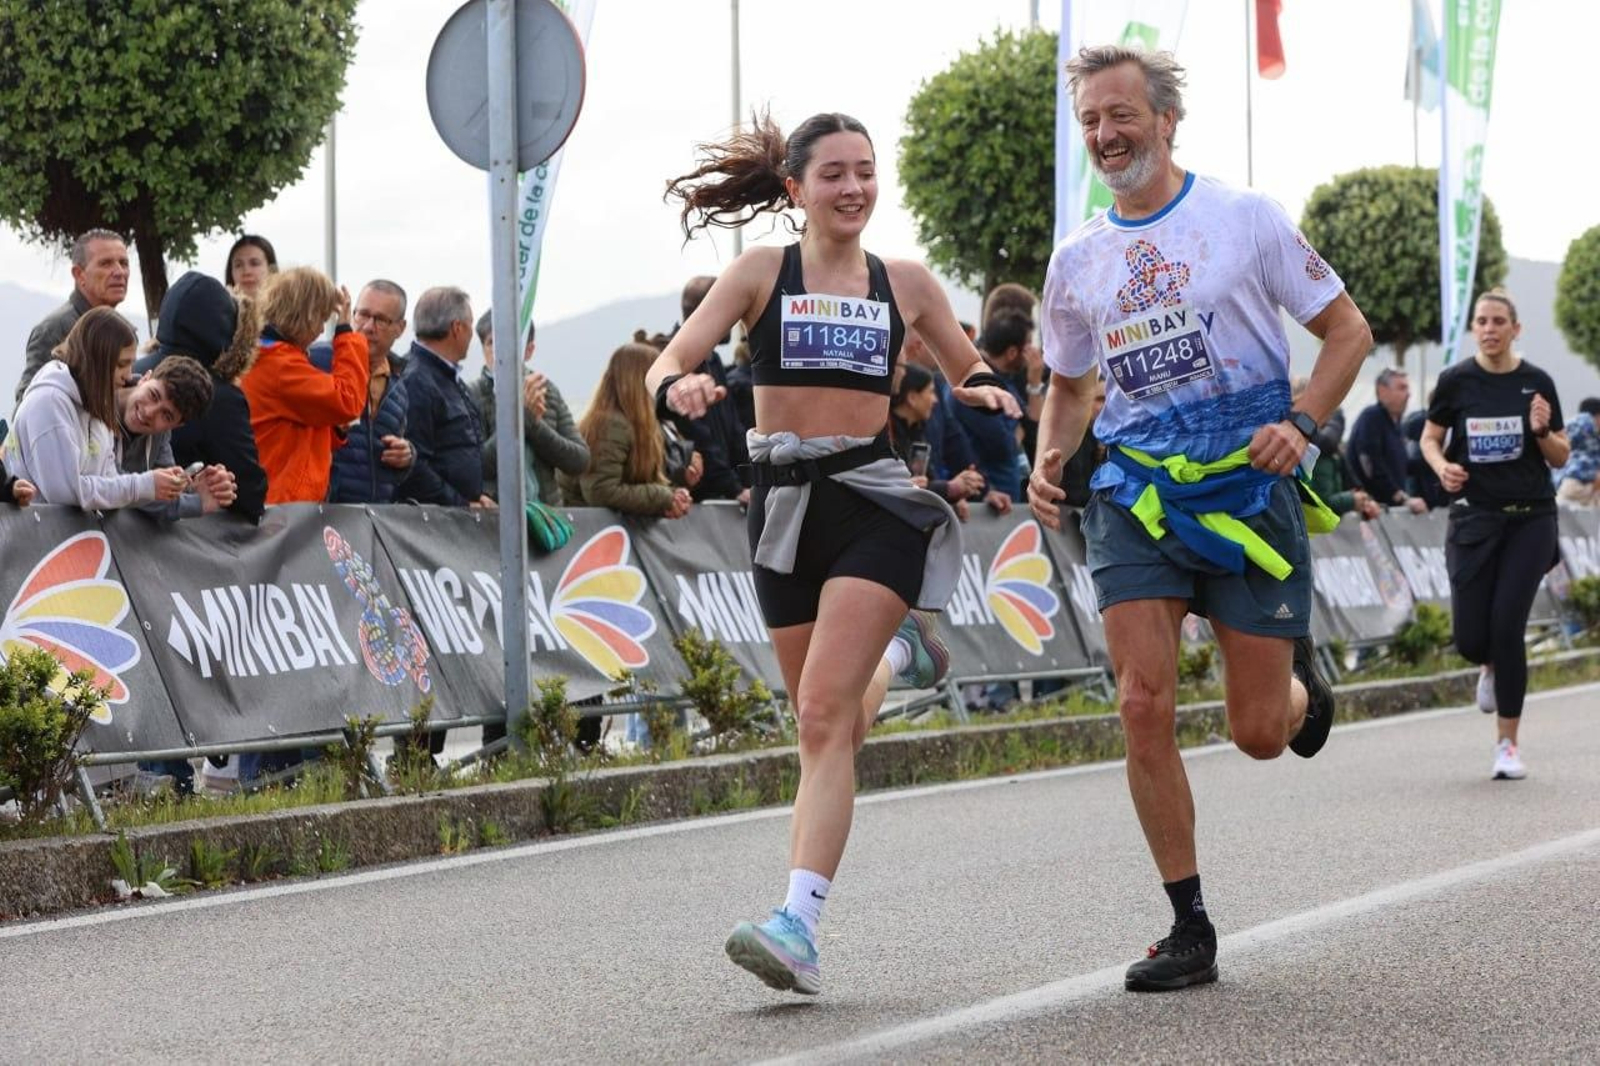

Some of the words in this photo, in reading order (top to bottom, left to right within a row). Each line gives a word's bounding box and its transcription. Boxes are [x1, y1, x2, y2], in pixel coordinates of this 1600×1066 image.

[526, 185, 544, 203] la
[519, 208, 539, 237] de
[791, 299, 880, 321] MINIBAY
[803, 324, 877, 352] 11845
[1106, 310, 1186, 350] MINIBAY
[1122, 338, 1193, 377] 11248
[1149, 370, 1171, 383] MANU
[674, 571, 771, 643] MINI
[170, 582, 359, 679] MINIBAY
